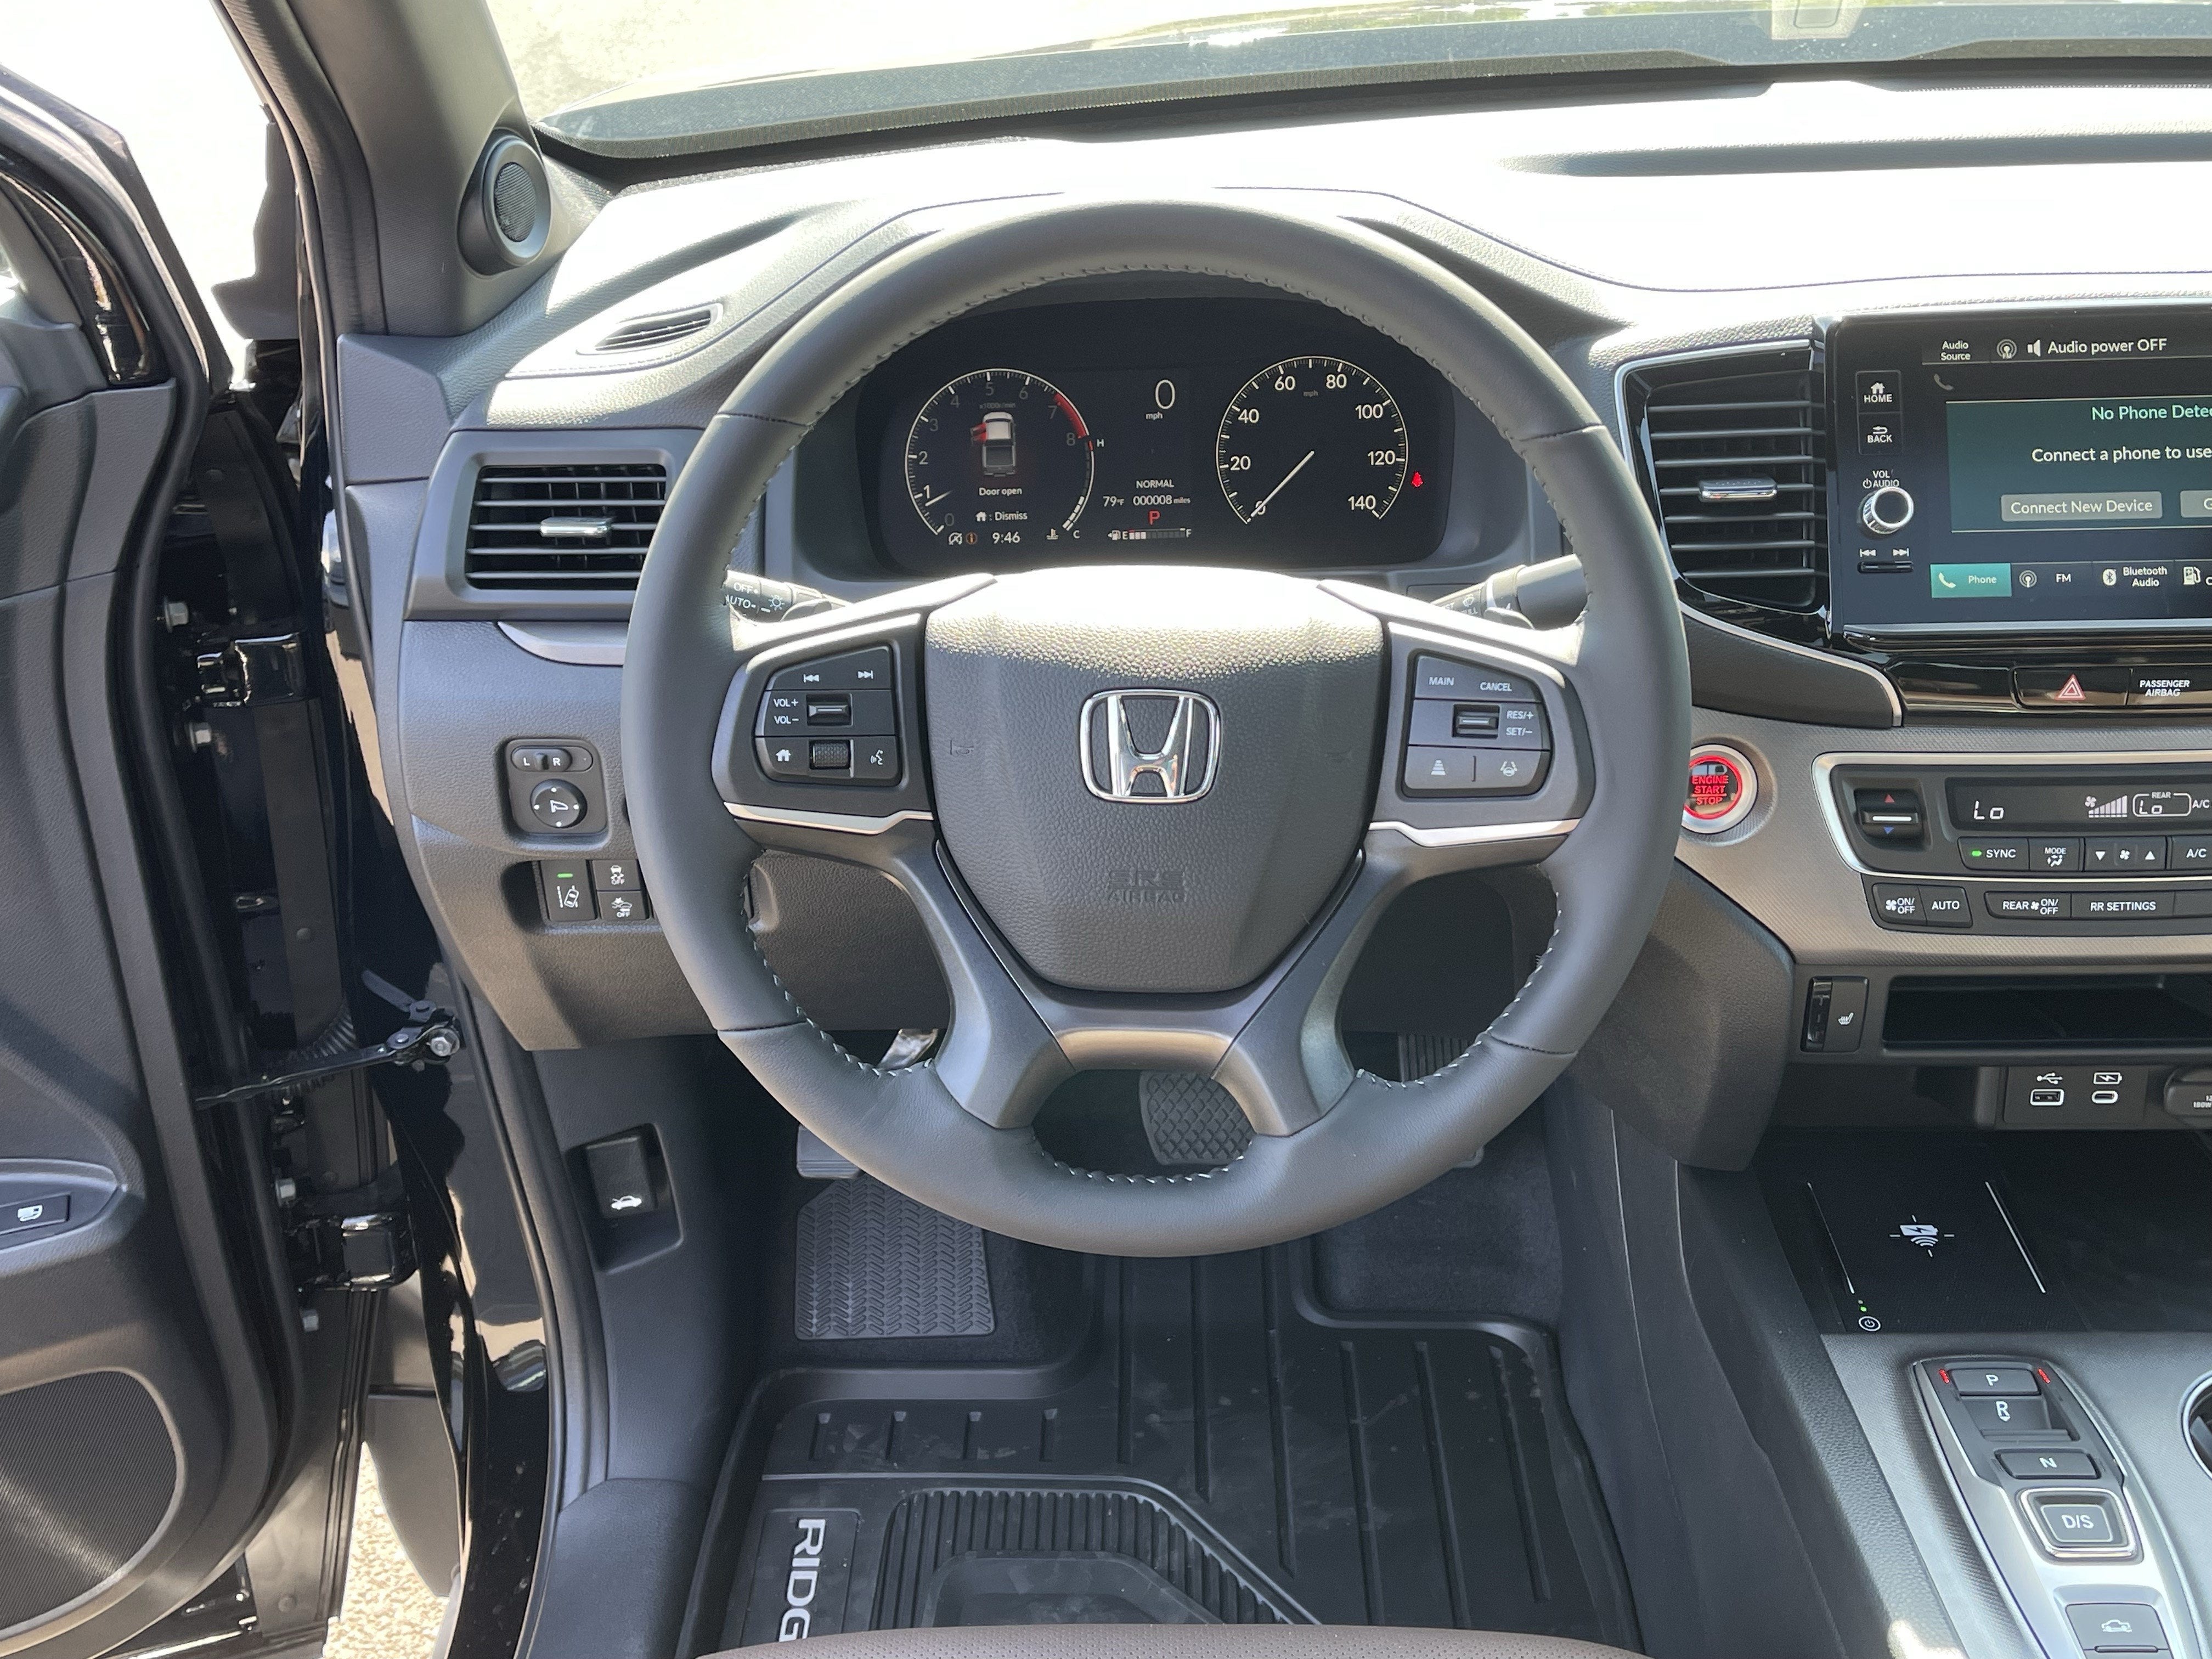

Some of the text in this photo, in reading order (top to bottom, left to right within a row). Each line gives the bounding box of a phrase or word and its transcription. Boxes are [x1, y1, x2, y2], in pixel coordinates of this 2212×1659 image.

[1942, 340, 1969, 350] Audio
[2047, 338, 2168, 356] Audio power OFF
[1940, 352, 1971, 361] Source
[1274, 376, 1296, 391] 60
[1325, 374, 1347, 389] 80
[986, 382, 994, 396] 5
[1019, 386, 1028, 399] 6
[1155, 379, 1176, 410] 0
[950, 395, 960, 408] 4
[1864, 394, 1893, 403] HOME
[1047, 405, 1058, 419] 7
[1146, 413, 1163, 421] mph
[1238, 409, 1260, 424] 40
[1355, 404, 1384, 419] 100
[2092, 407, 2114, 420] No
[2119, 405, 2168, 420] Phone
[929, 419, 939, 432] 3
[1066, 433, 1076, 446] 8
[1867, 435, 1893, 443] BACK
[918, 452, 928, 465] 2
[1367, 451, 1396, 466] 120
[2032, 446, 2212, 465] Connect a phone to use
[1229, 456, 1251, 471] 20
[1872, 470, 1891, 479] VOL
[1136, 479, 1175, 488] NORMAL
[1872, 478, 1900, 488] AUDIO
[923, 485, 930, 498] 1
[979, 487, 1023, 498] Door open
[1133, 494, 1172, 505] 000008
[1347, 495, 1376, 510] 140
[2011, 499, 2153, 514] Connect New Device
[944, 512, 955, 527] 0
[994, 510, 1028, 521] Dismiss
[1148, 510, 1161, 525] P
[992, 532, 1020, 544] 9:46
[1073, 531, 1080, 539] C
[1122, 531, 1129, 540] E
[1185, 528, 1192, 538] F
[2123, 566, 2168, 577] Bluetooth
[1967, 575, 1997, 584] Phone
[2055, 573, 2072, 583] FM
[2132, 577, 2160, 588] Audio
[733, 582, 754, 594] OFF
[1429, 676, 1454, 686] MAIN
[2139, 679, 2191, 689] PASSENGER
[1480, 682, 1513, 692] CANCEL
[2145, 689, 2181, 698] AIRBAG
[523, 757, 531, 766] L
[552, 757, 561, 766] R
[1691, 775, 1729, 785] ENGINE
[1694, 785, 1726, 794] START
[1696, 796, 1723, 805] STOP
[2193, 800, 2210, 809] A/C
[1973, 800, 2005, 820] Lo
[2139, 800, 2163, 815] Lo
[1986, 849, 2016, 859] SYNC
[2186, 848, 2207, 859] A/C
[1896, 897, 1915, 906] ON/
[1931, 901, 1960, 910] AUTO
[2002, 901, 2029, 911] REAR
[2040, 899, 2059, 907] ON/
[2090, 901, 2156, 911] RR SETTINGS
[1897, 906, 1916, 915] OFF
[2040, 907, 2058, 915] OFF
[1985, 1374, 1999, 1386] P
[1995, 1401, 2009, 1416] R
[2039, 1457, 2057, 1469] N
[2061, 1514, 2095, 1530] D/S
